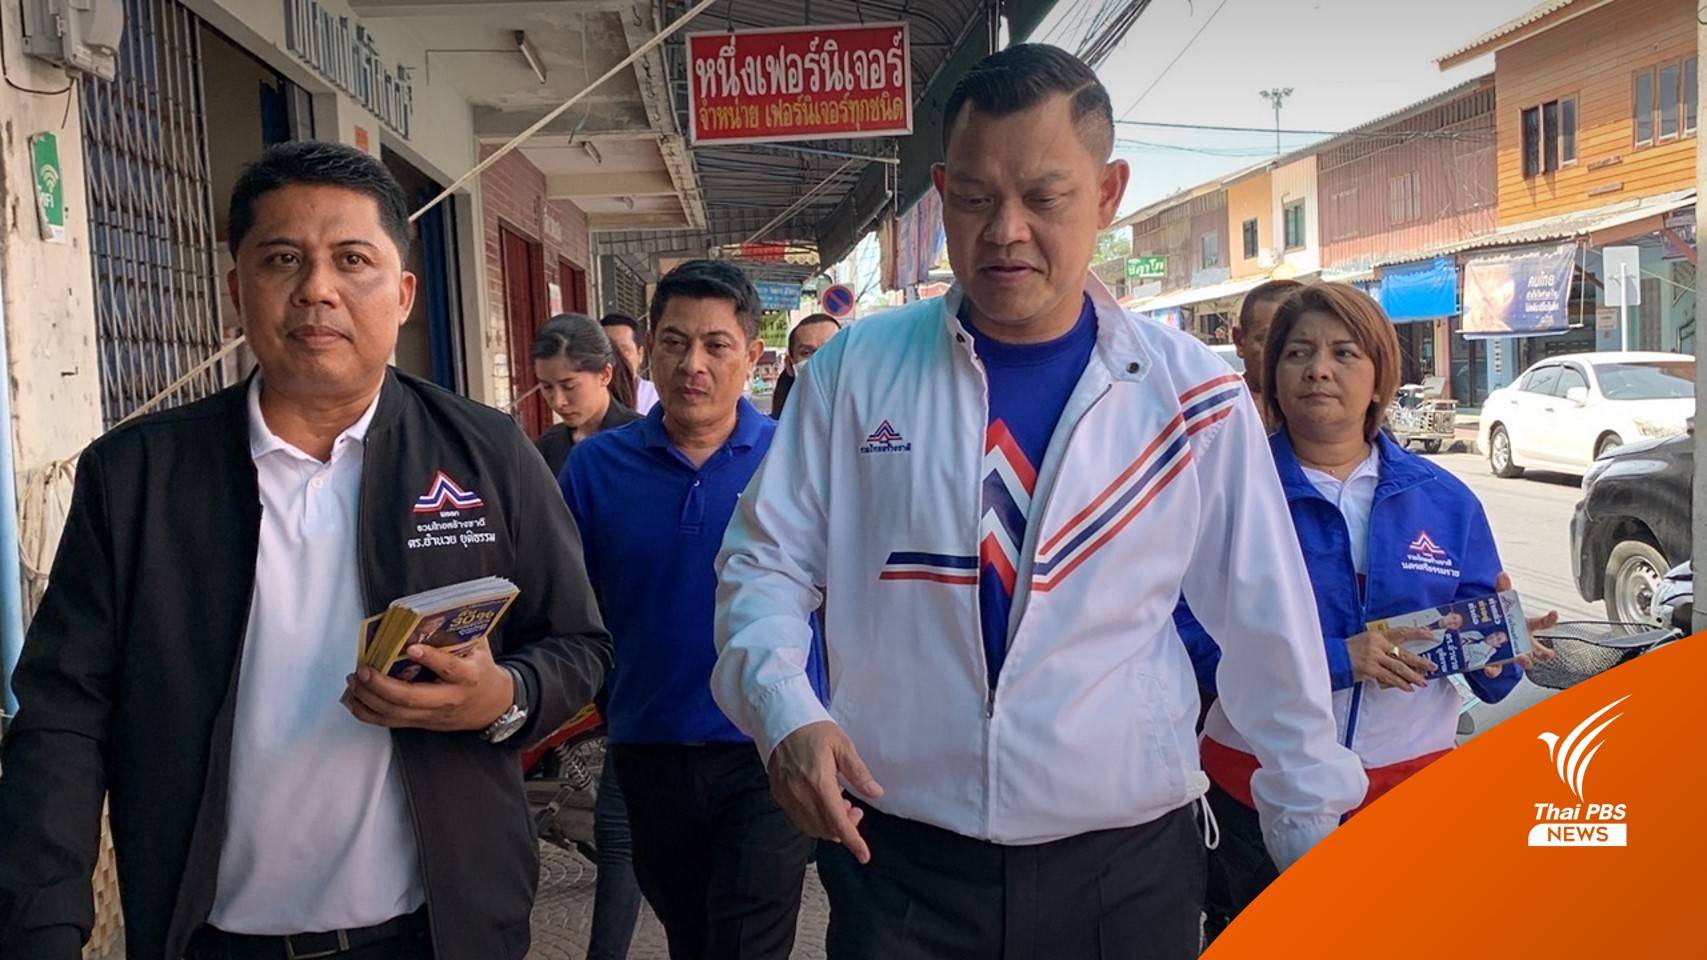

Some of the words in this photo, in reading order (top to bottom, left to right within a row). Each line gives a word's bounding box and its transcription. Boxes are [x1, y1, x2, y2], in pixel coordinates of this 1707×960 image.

[695, 31, 904, 98] หนึ่งเฟอร์นิเจอร์
[700, 97, 759, 130] จำหน่าย
[765, 91, 904, 130] เฟอร์นิเจอร์ทุกชนิด
[416, 517, 486, 533] รวมไทยสร้างชาติ
[459, 530, 496, 548] ยุติธรรม
